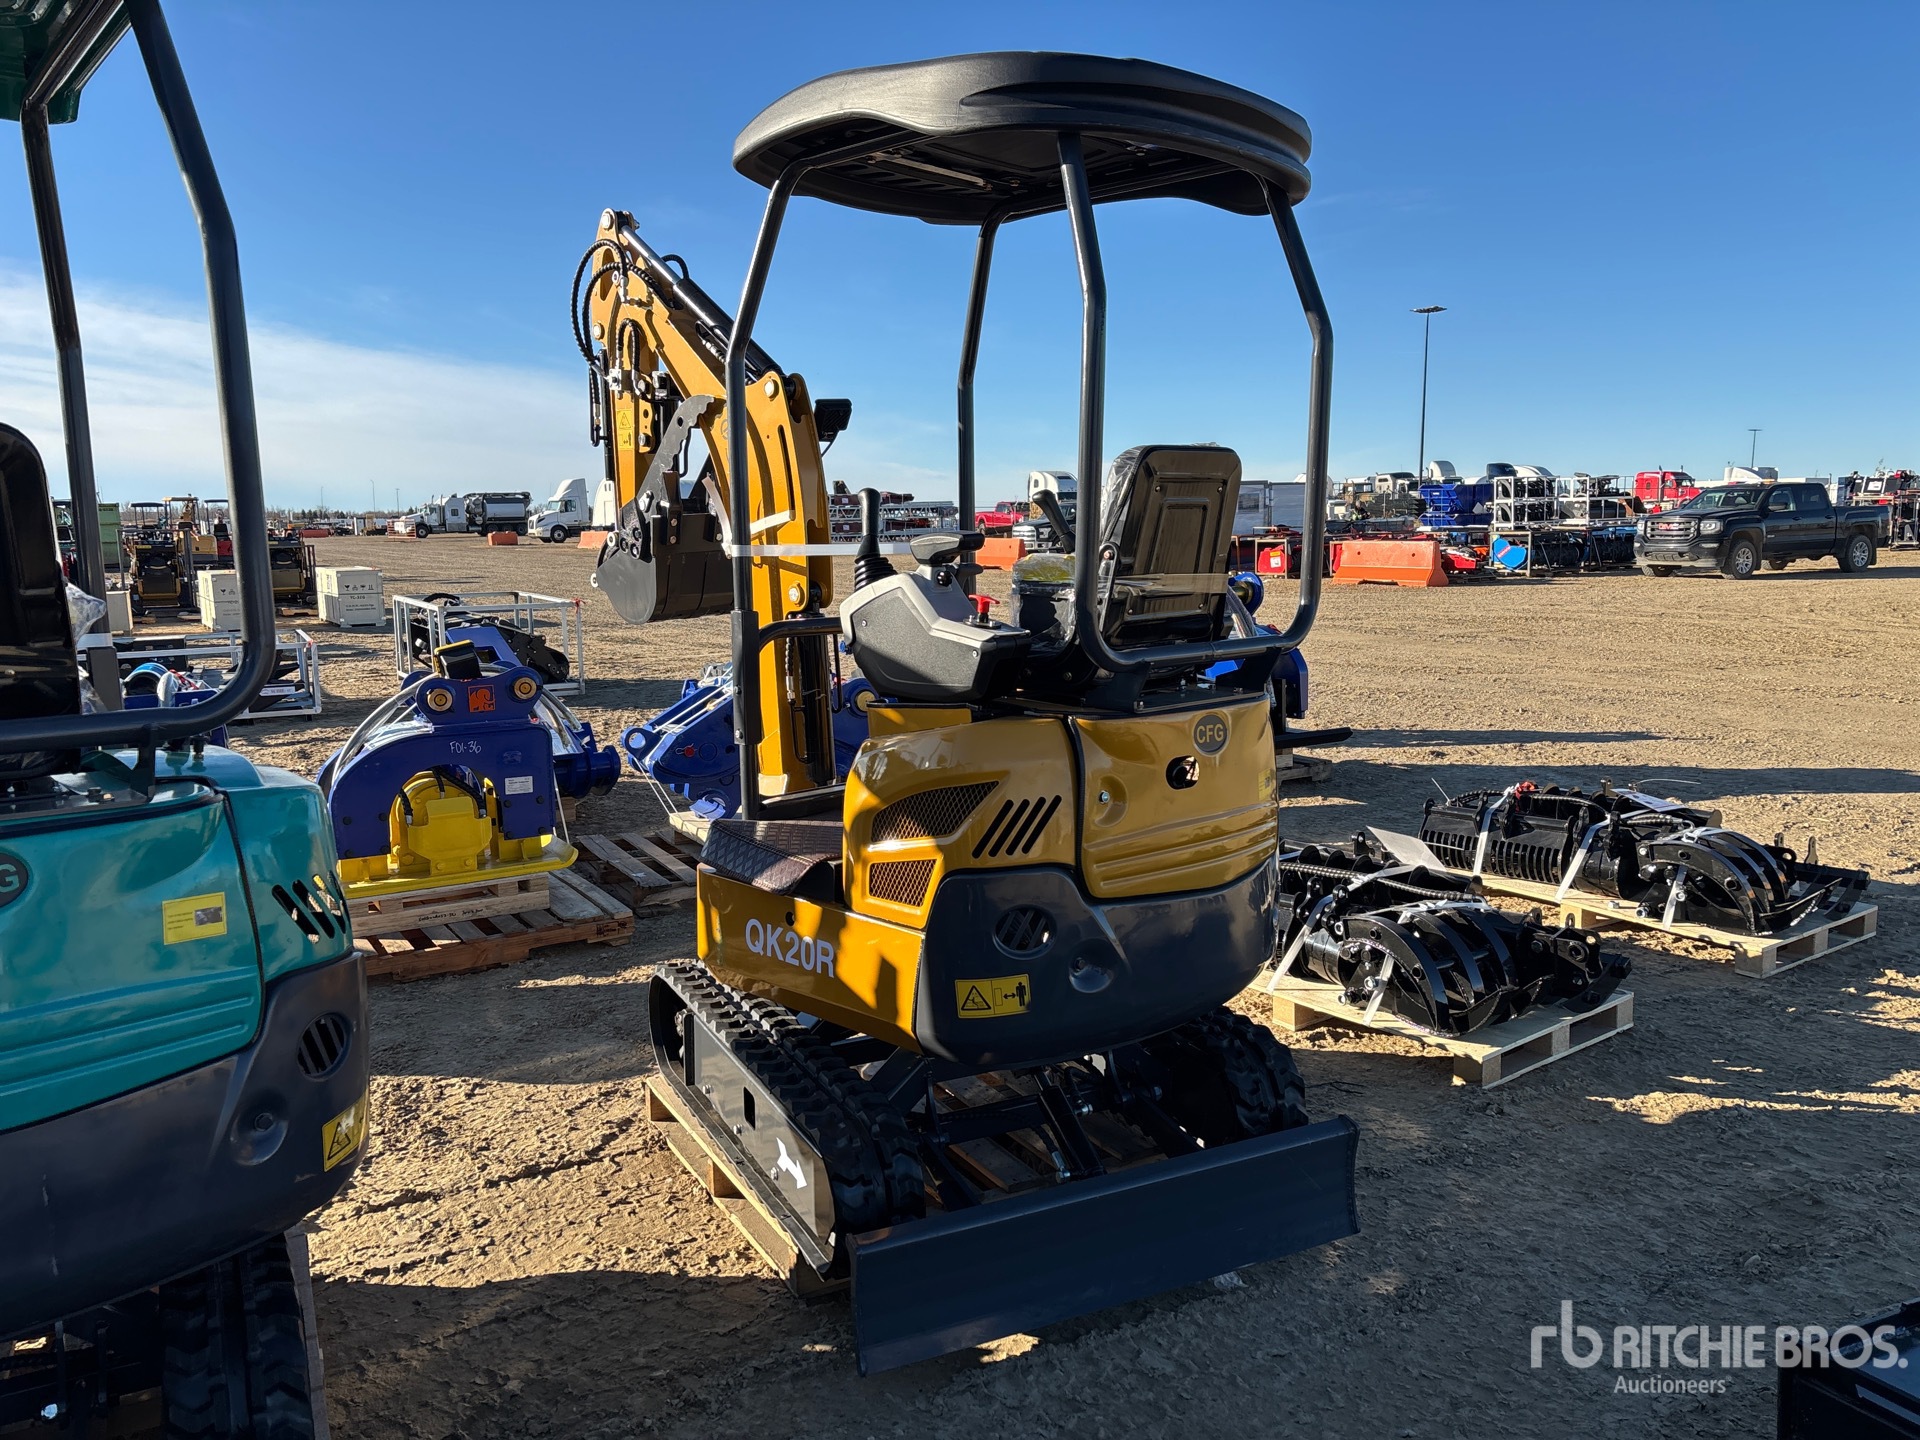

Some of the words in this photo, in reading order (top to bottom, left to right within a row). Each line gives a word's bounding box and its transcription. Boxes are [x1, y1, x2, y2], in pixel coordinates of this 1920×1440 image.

[1657, 522, 1680, 530] GMC
[1196, 723, 1224, 744] CFG
[745, 917, 836, 978] QK20R
